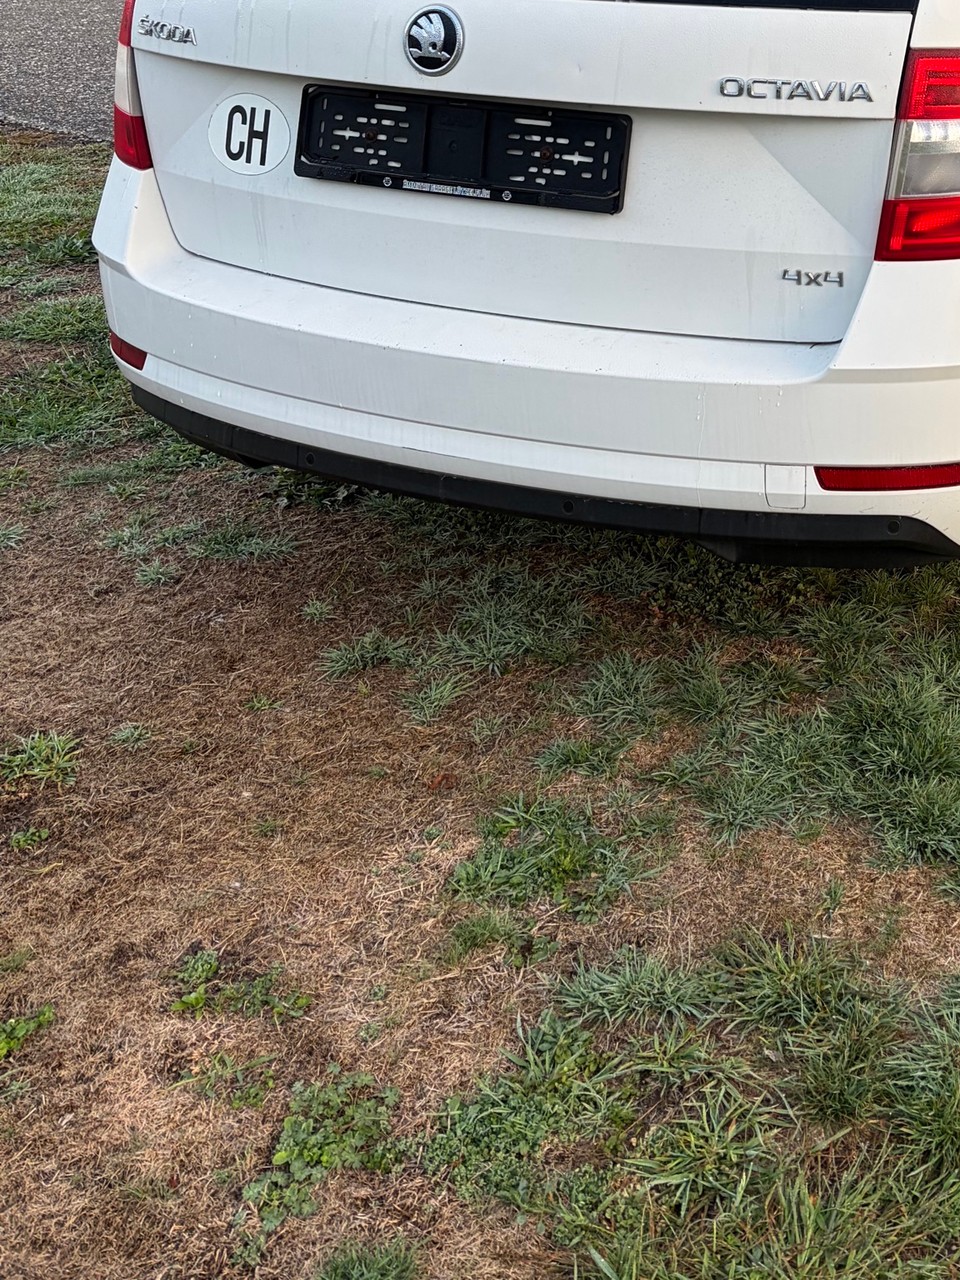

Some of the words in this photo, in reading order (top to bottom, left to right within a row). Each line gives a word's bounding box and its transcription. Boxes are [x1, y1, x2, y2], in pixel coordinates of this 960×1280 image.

[138, 14, 197, 46] ŠKODA
[719, 76, 874, 102] OCTAVIA
[225, 105, 271, 166] CH
[782, 269, 843, 288] 4x4
